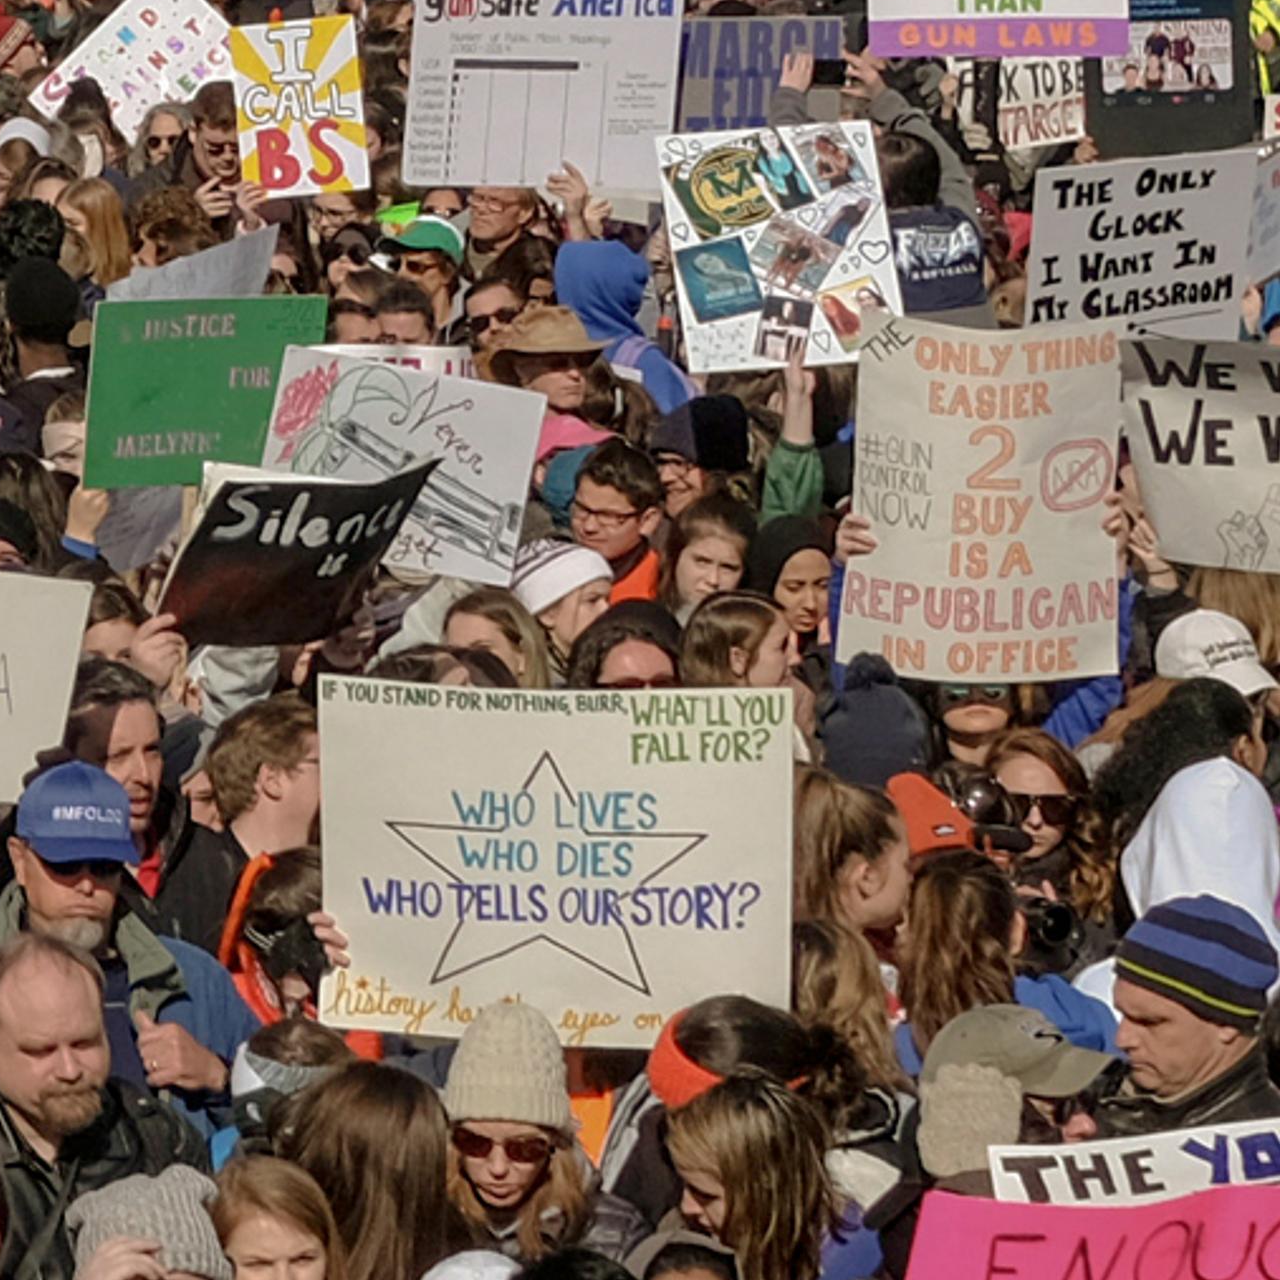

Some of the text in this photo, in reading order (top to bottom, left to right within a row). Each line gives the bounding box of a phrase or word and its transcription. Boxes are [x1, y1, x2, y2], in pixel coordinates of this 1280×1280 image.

[266, 25, 316, 84] I
[899, 23, 1098, 48] GUN LAWS
[243, 84, 357, 123] CALL
[256, 120, 345, 190] BS
[1054, 168, 1216, 209] THE ONLY
[1089, 209, 1184, 241] GLOCK
[143, 313, 236, 341] JUSTICE
[915, 331, 1118, 376] ONLY THING
[228, 366, 272, 390] FOR
[928, 382, 1052, 418] EASIER
[844, 572, 1115, 631] REPUBLICAN
[882, 636, 1078, 674] IN OFFICE
[321, 680, 627, 716] IF YOU STAND FOR NOTHING, BURR,
[452, 790, 657, 831] WHO LIVES
[362, 877, 761, 930] WHO TELLS OUR STORY?
[1000, 1150, 1164, 1203] THE
